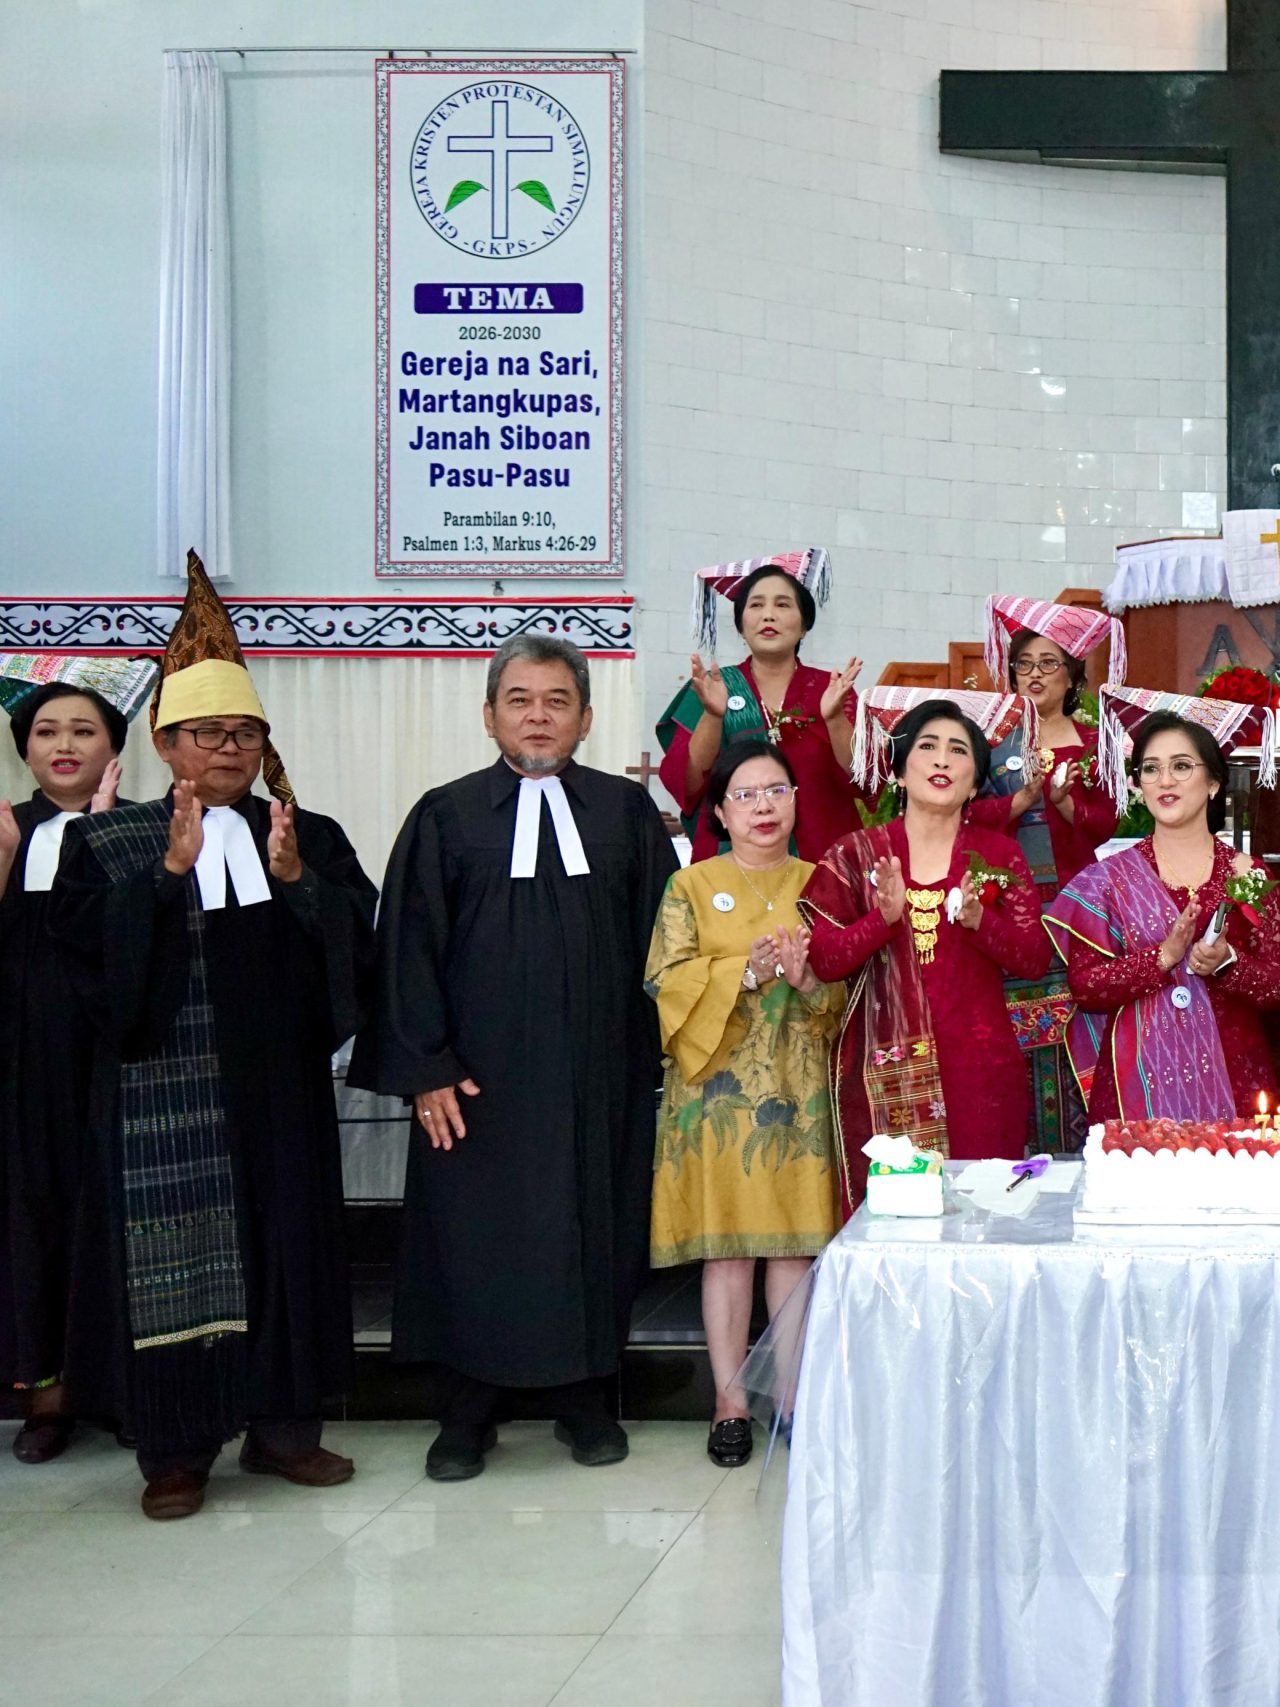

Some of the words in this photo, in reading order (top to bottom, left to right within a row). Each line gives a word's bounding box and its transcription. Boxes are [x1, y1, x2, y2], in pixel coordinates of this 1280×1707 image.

[462, 84, 567, 123] PROTESTAN
[414, 98, 461, 170] KRISTEN
[541, 123, 586, 241] SIMALUNGUN
[416, 175, 459, 239] GEREJA
[443, 287, 555, 310] TEMA
[458, 326, 541, 340] 2026-2030
[401, 349, 488, 381] Gereja
[498, 356, 530, 376] na
[539, 349, 598, 380] Sari,
[399, 388, 601, 419] Martangkupas,
[408, 425, 490, 451] Janah
[500, 424, 590, 451] Siboan
[429, 462, 570, 488] Pasu-Pasu
[443, 511, 518, 527] Parambilan
[522, 511, 556, 530] 9:10,
[403, 535, 459, 552] Psalmen
[463, 535, 488, 555] 1:3,
[492, 535, 542, 552] Markus
[545, 535, 597, 552] 4:26-29
